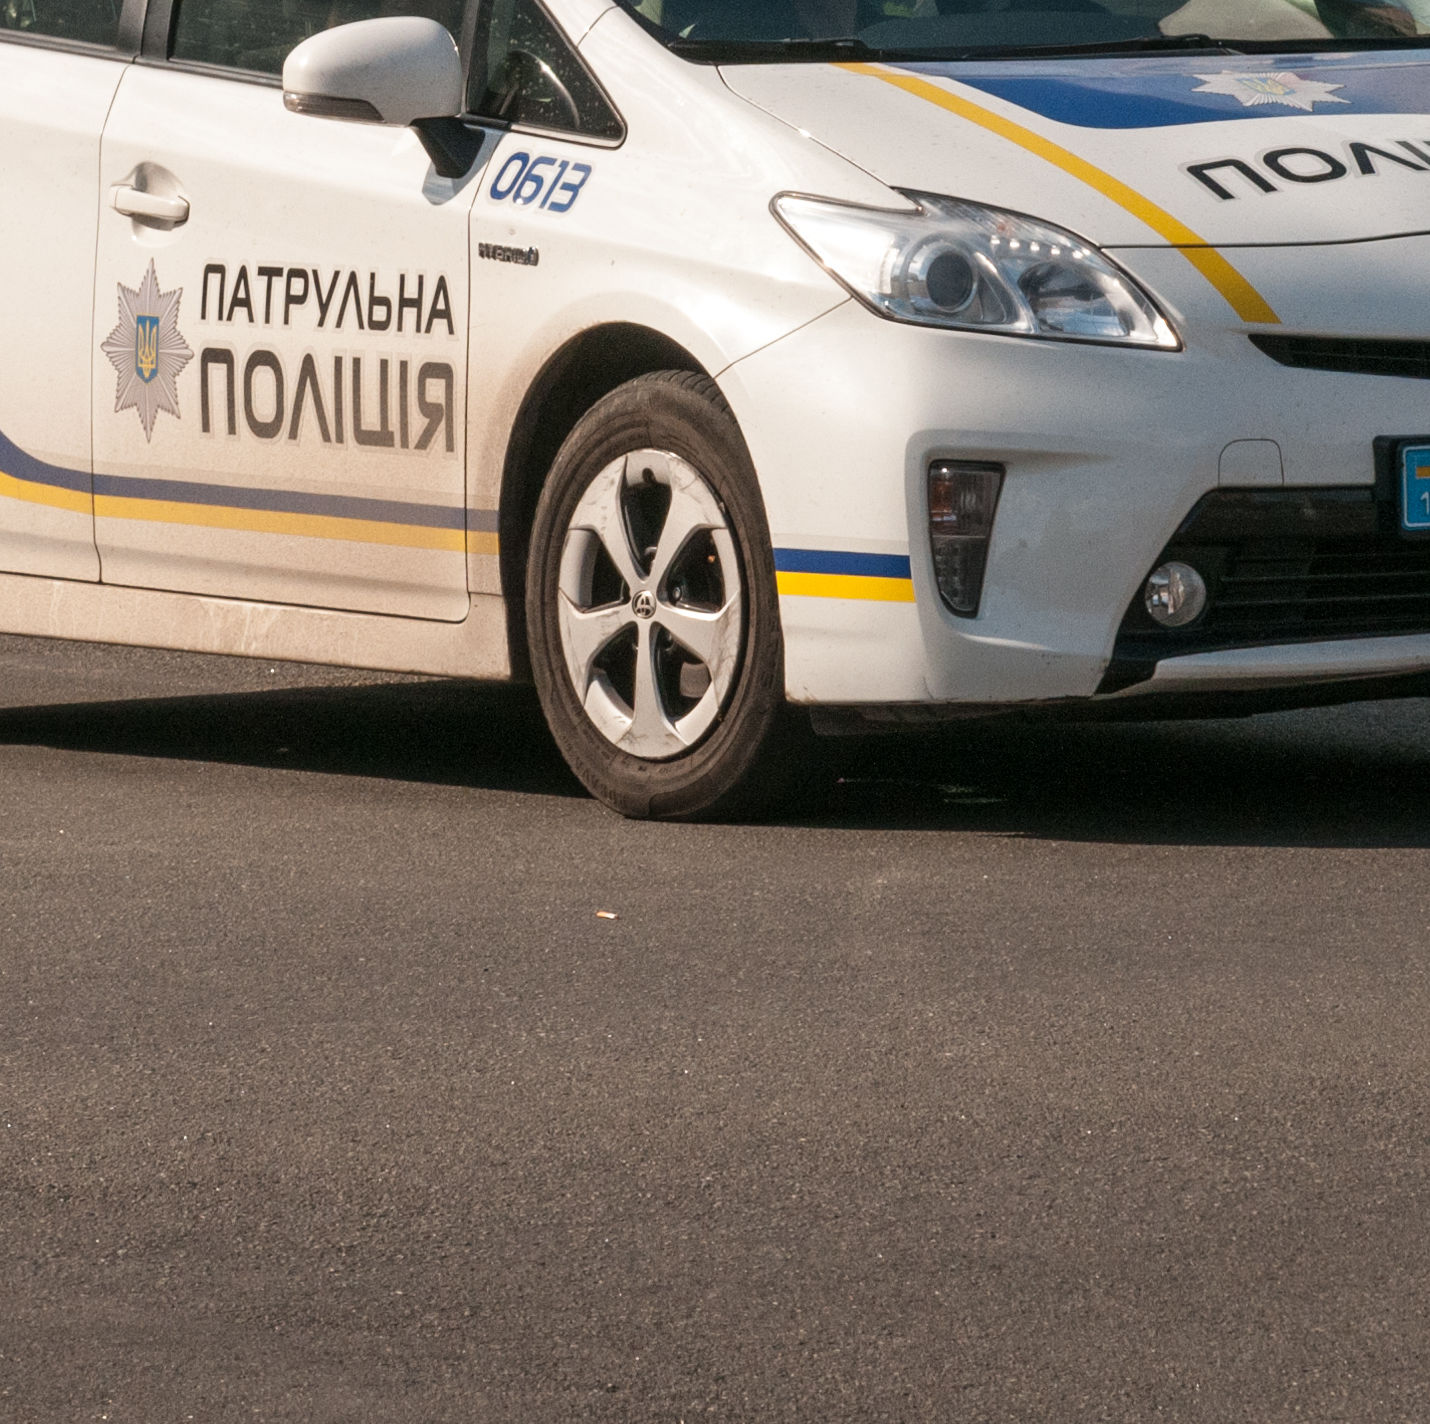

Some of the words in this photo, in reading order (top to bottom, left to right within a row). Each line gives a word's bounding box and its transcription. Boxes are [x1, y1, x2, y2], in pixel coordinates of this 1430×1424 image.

[489, 151, 592, 213] 0613
[200, 263, 455, 336] ПАТРУЛЬНА
[200, 347, 455, 453] ПОЛІЦІЯ
